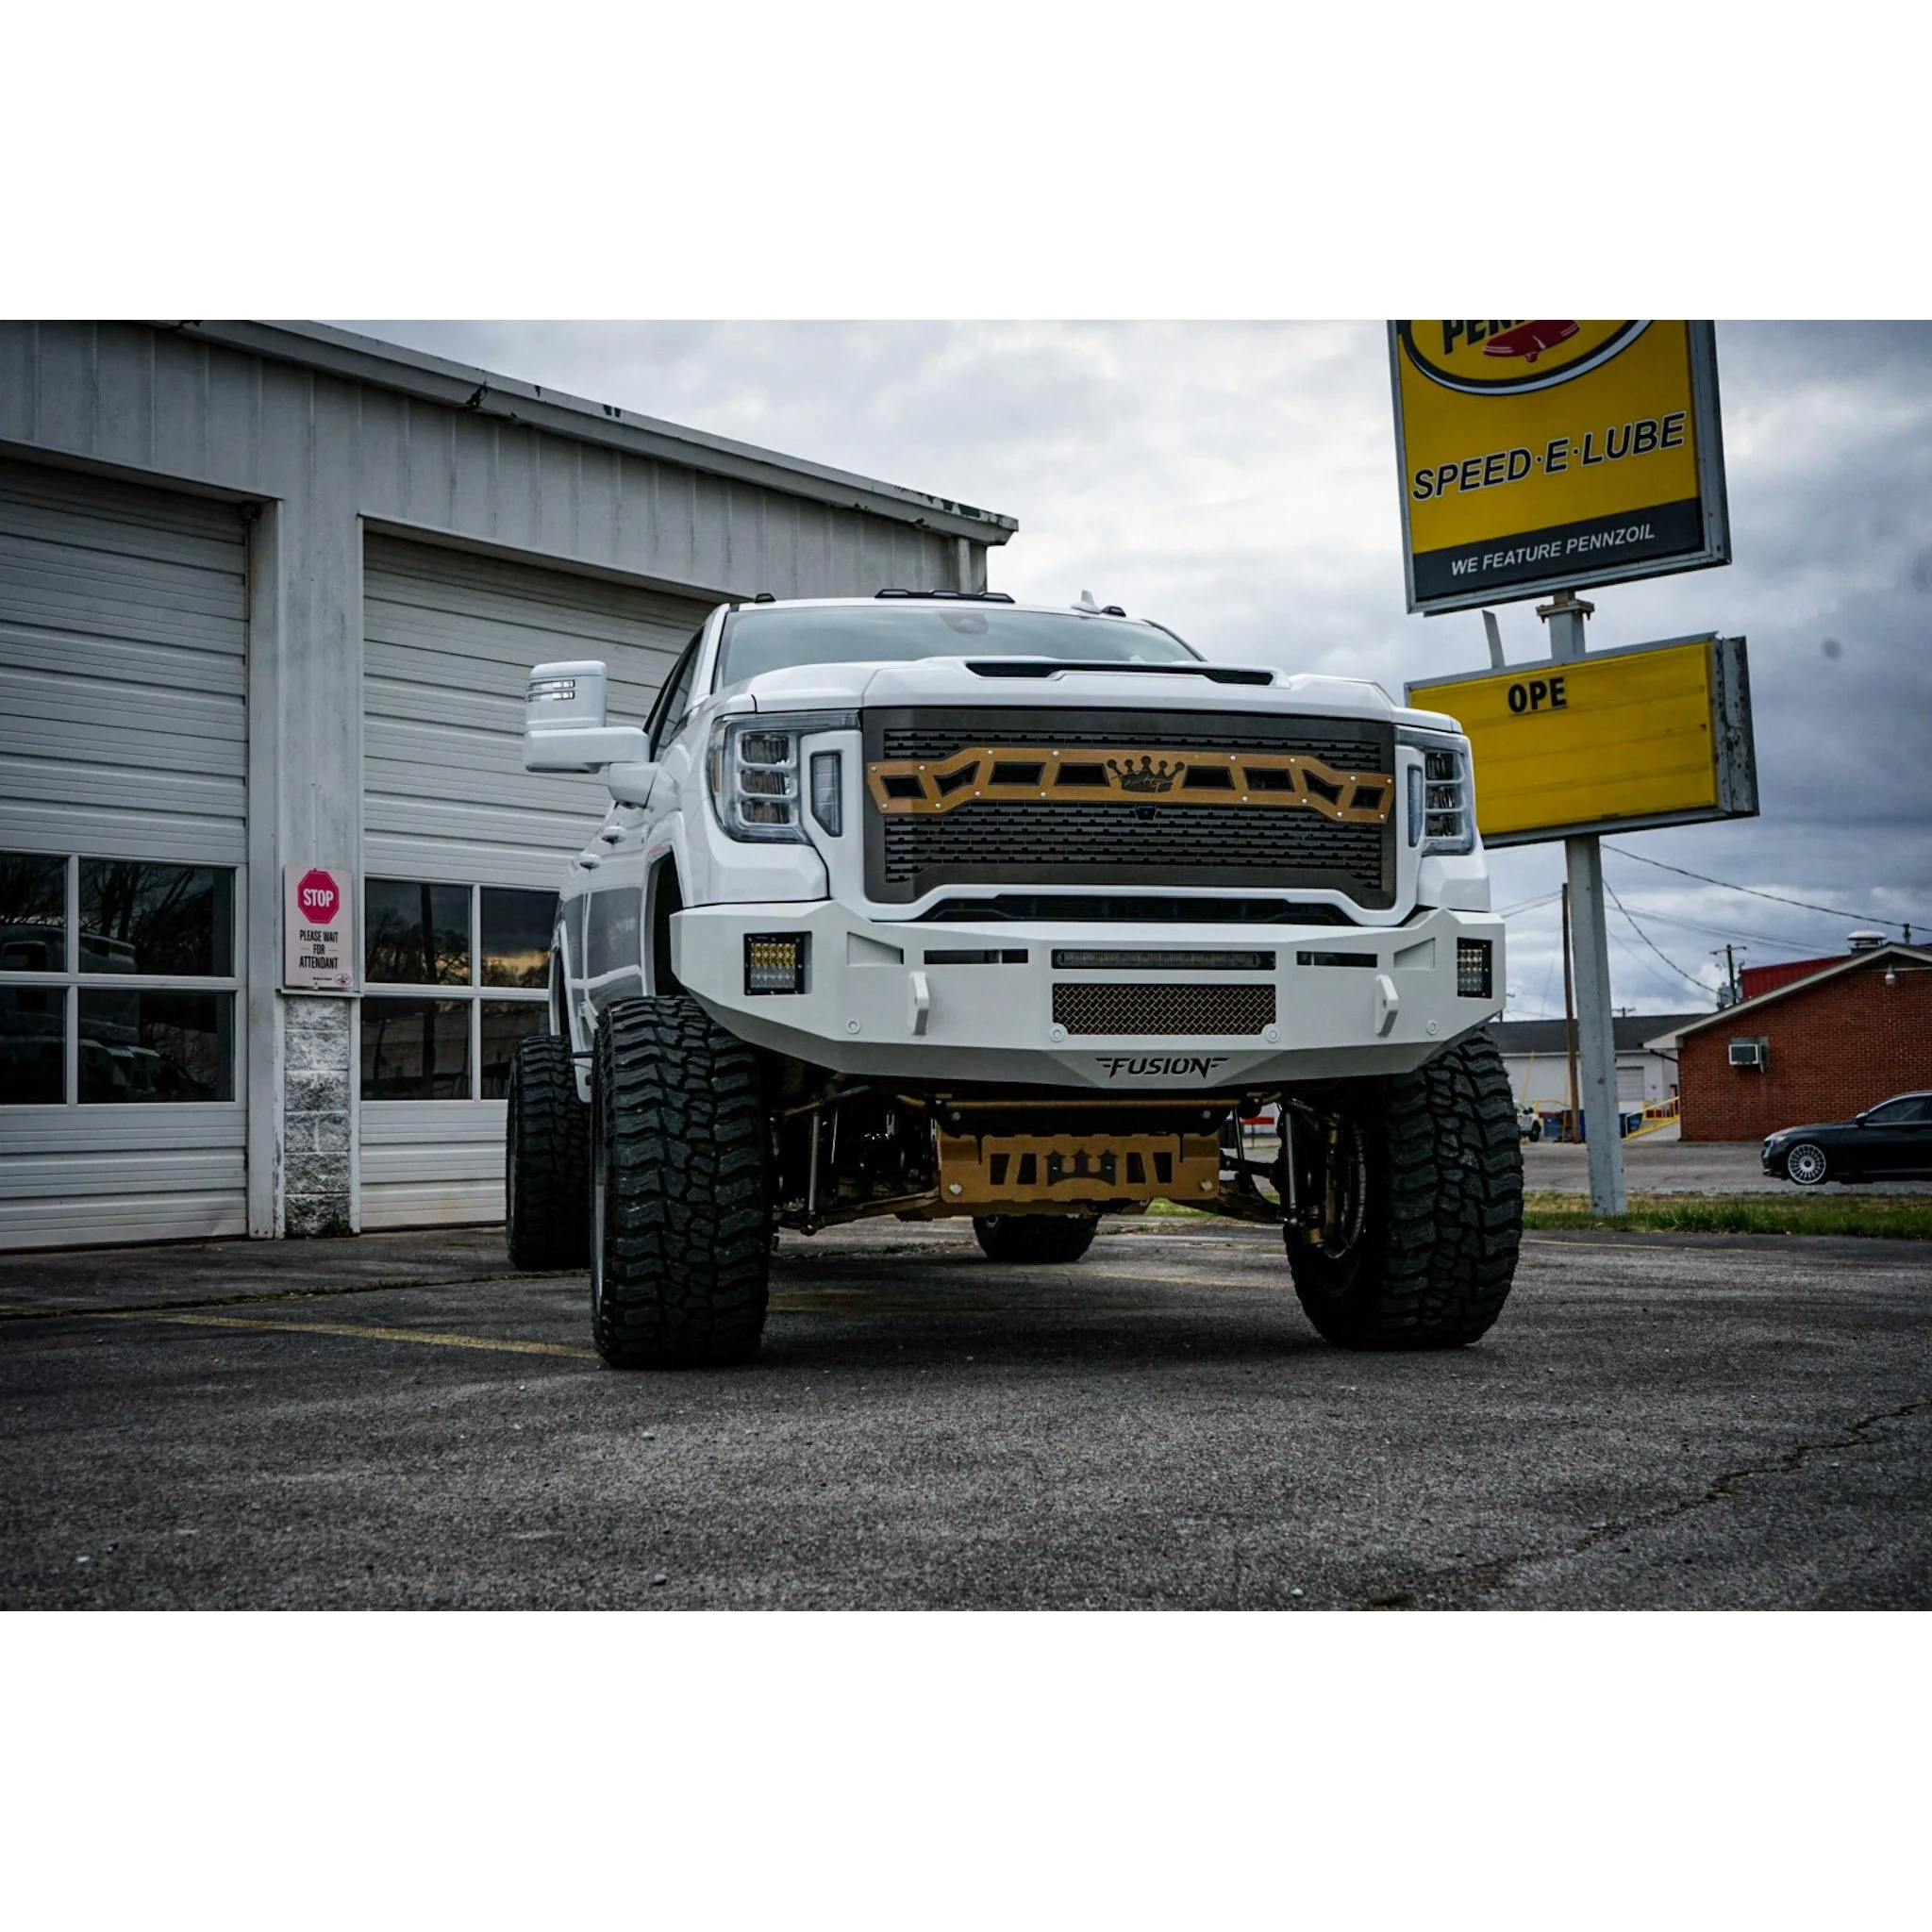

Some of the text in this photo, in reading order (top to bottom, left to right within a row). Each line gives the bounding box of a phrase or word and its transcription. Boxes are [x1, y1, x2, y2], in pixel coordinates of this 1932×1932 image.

[1452, 524, 1656, 576] WE FEATURE PENNZOIL
[1508, 676, 1567, 714] OPE
[303, 888, 334, 908] STOP
[300, 930, 339, 942] PLEASE WAIT
[313, 944, 325, 955] FOR
[299, 956, 339, 970] ATTENDANT
[1106, 1058, 1215, 1078] FUSION
